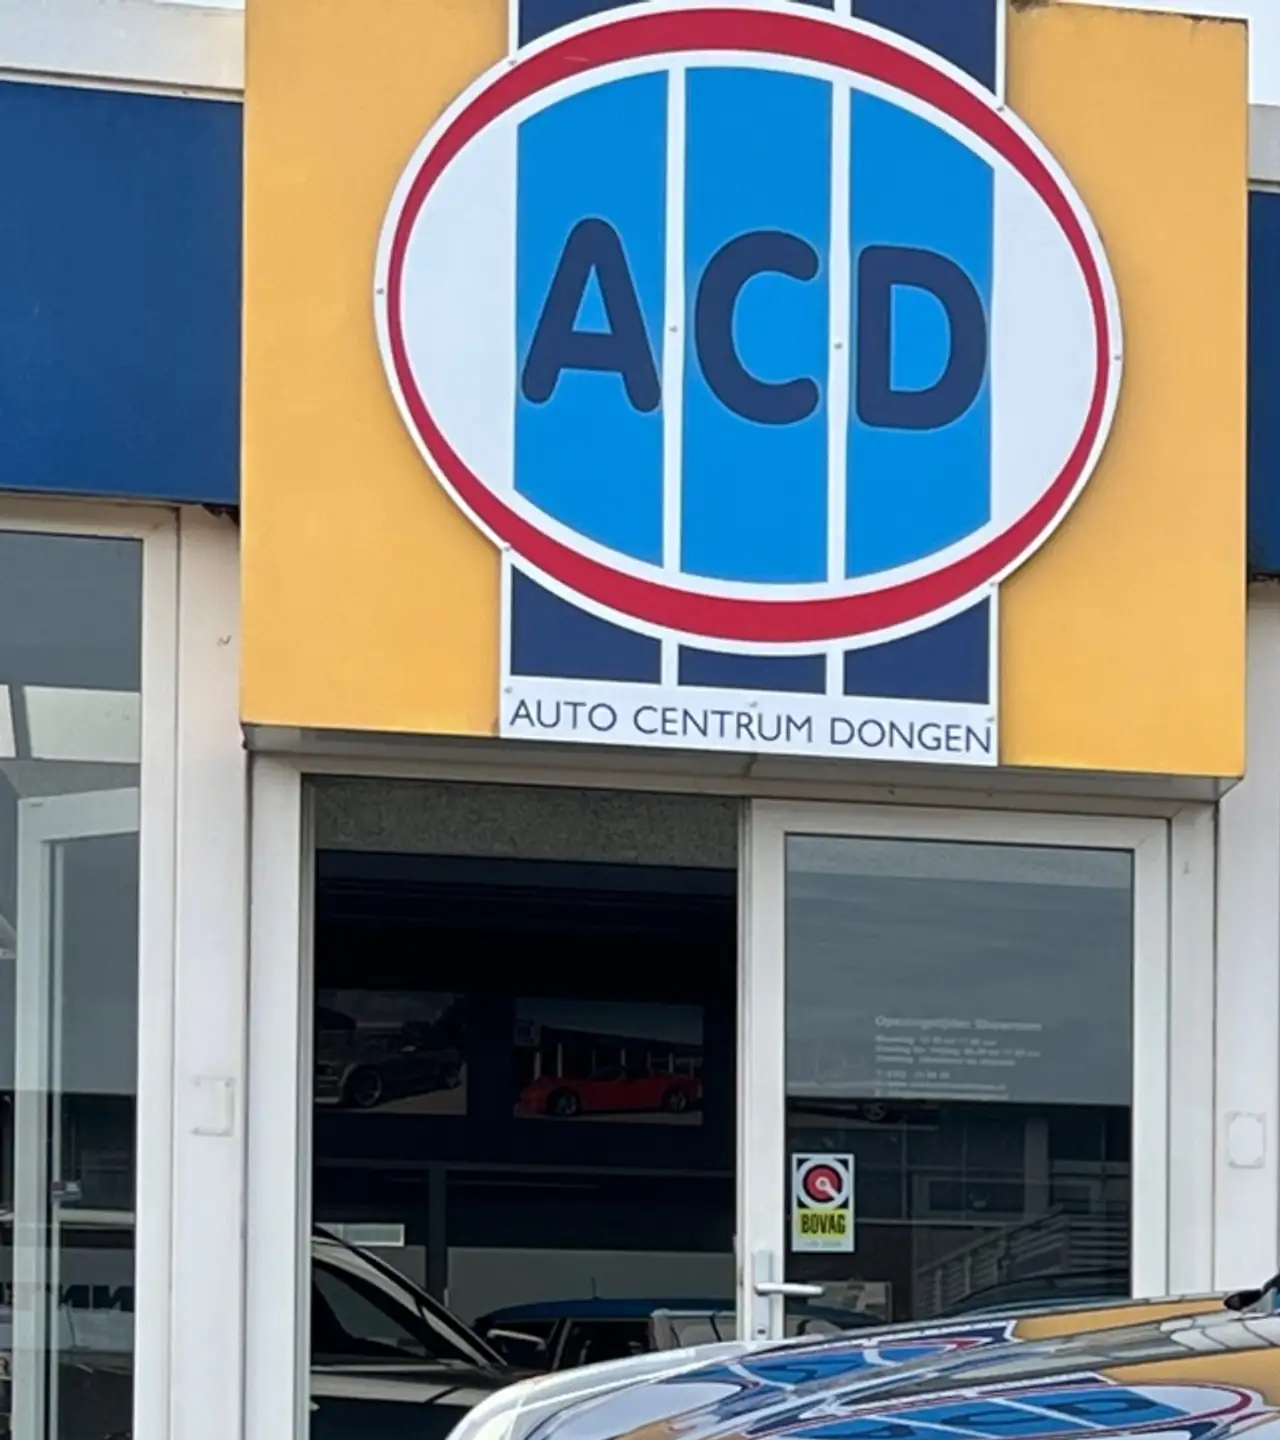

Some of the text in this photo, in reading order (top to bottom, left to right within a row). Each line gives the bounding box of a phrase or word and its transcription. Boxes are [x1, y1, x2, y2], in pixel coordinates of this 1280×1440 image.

[521, 217, 989, 431] ACD
[509, 699, 992, 754] AUTO CENTRUM DONGEN
[800, 1213, 846, 1236] BOVAG
